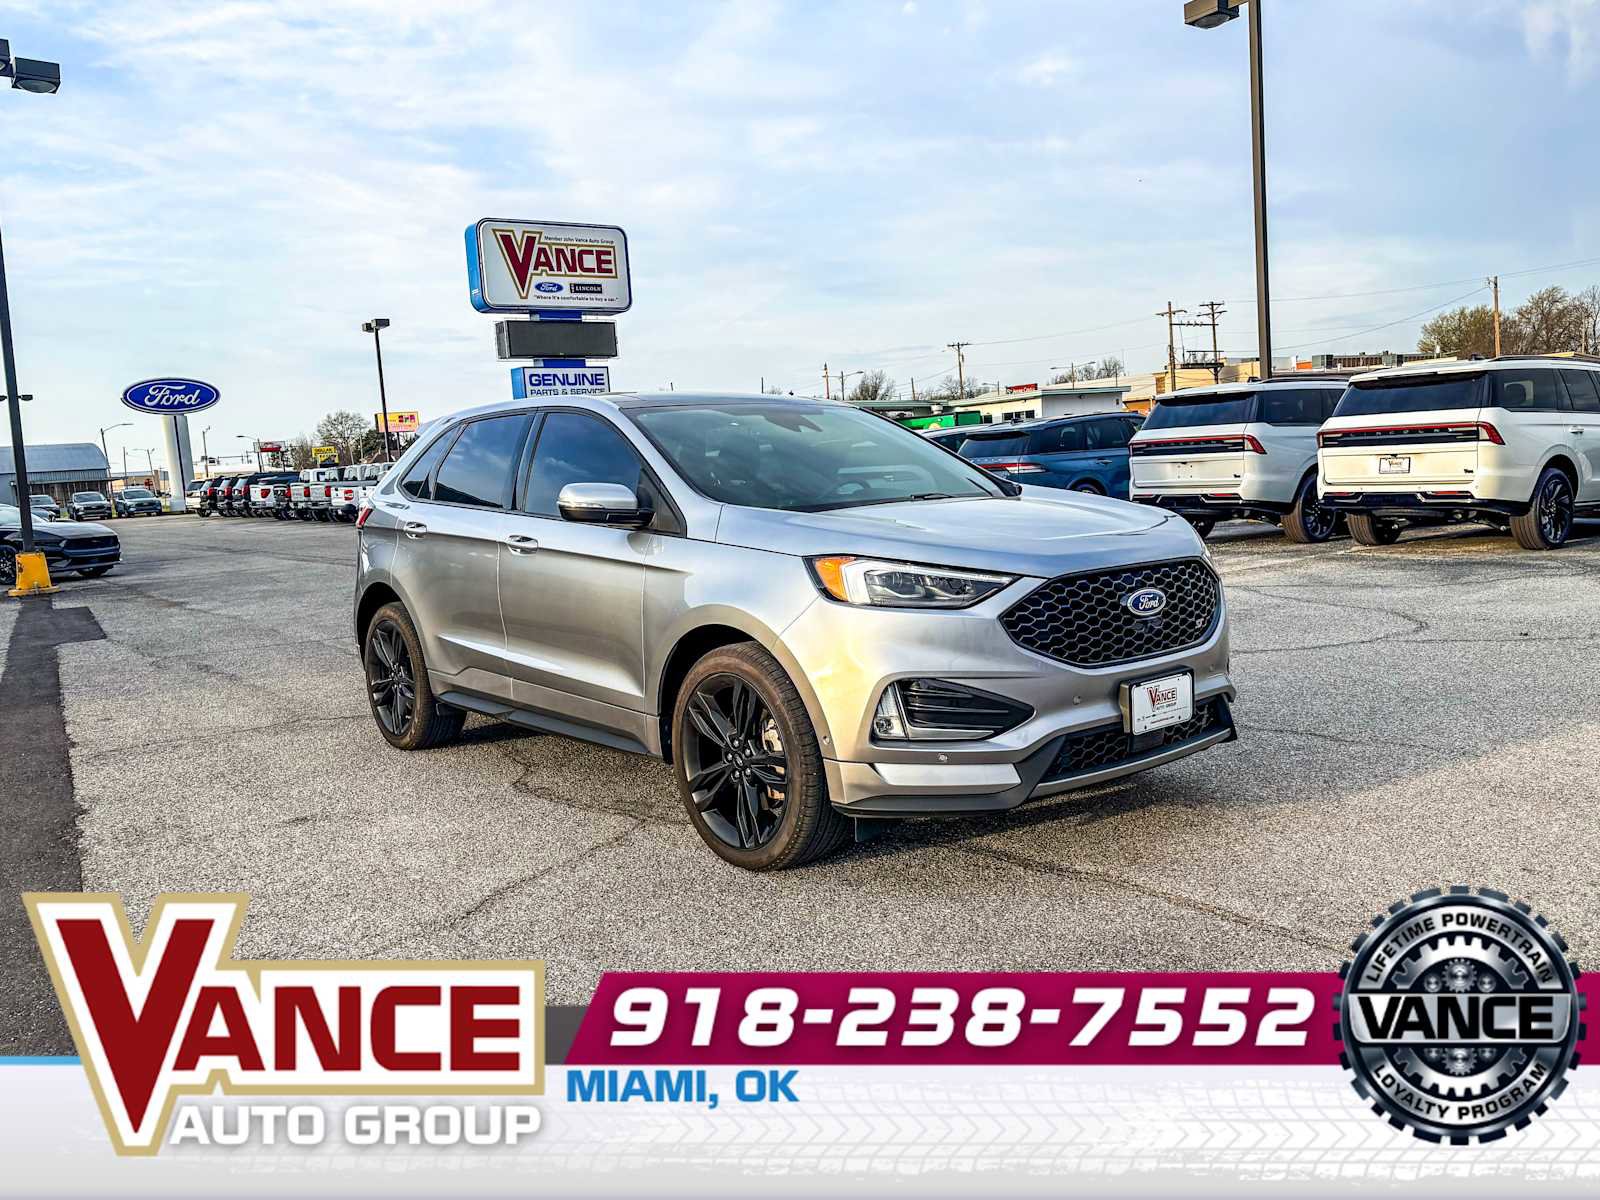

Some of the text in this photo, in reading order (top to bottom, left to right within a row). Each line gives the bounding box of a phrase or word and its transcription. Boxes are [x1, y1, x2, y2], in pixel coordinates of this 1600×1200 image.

[497, 232, 615, 295] VANCE
[540, 282, 558, 291] Ford
[529, 373, 605, 386] GENUINE
[144, 384, 200, 406] Ford
[1138, 594, 1160, 610] Ford
[1147, 687, 1176, 710] VANCE
